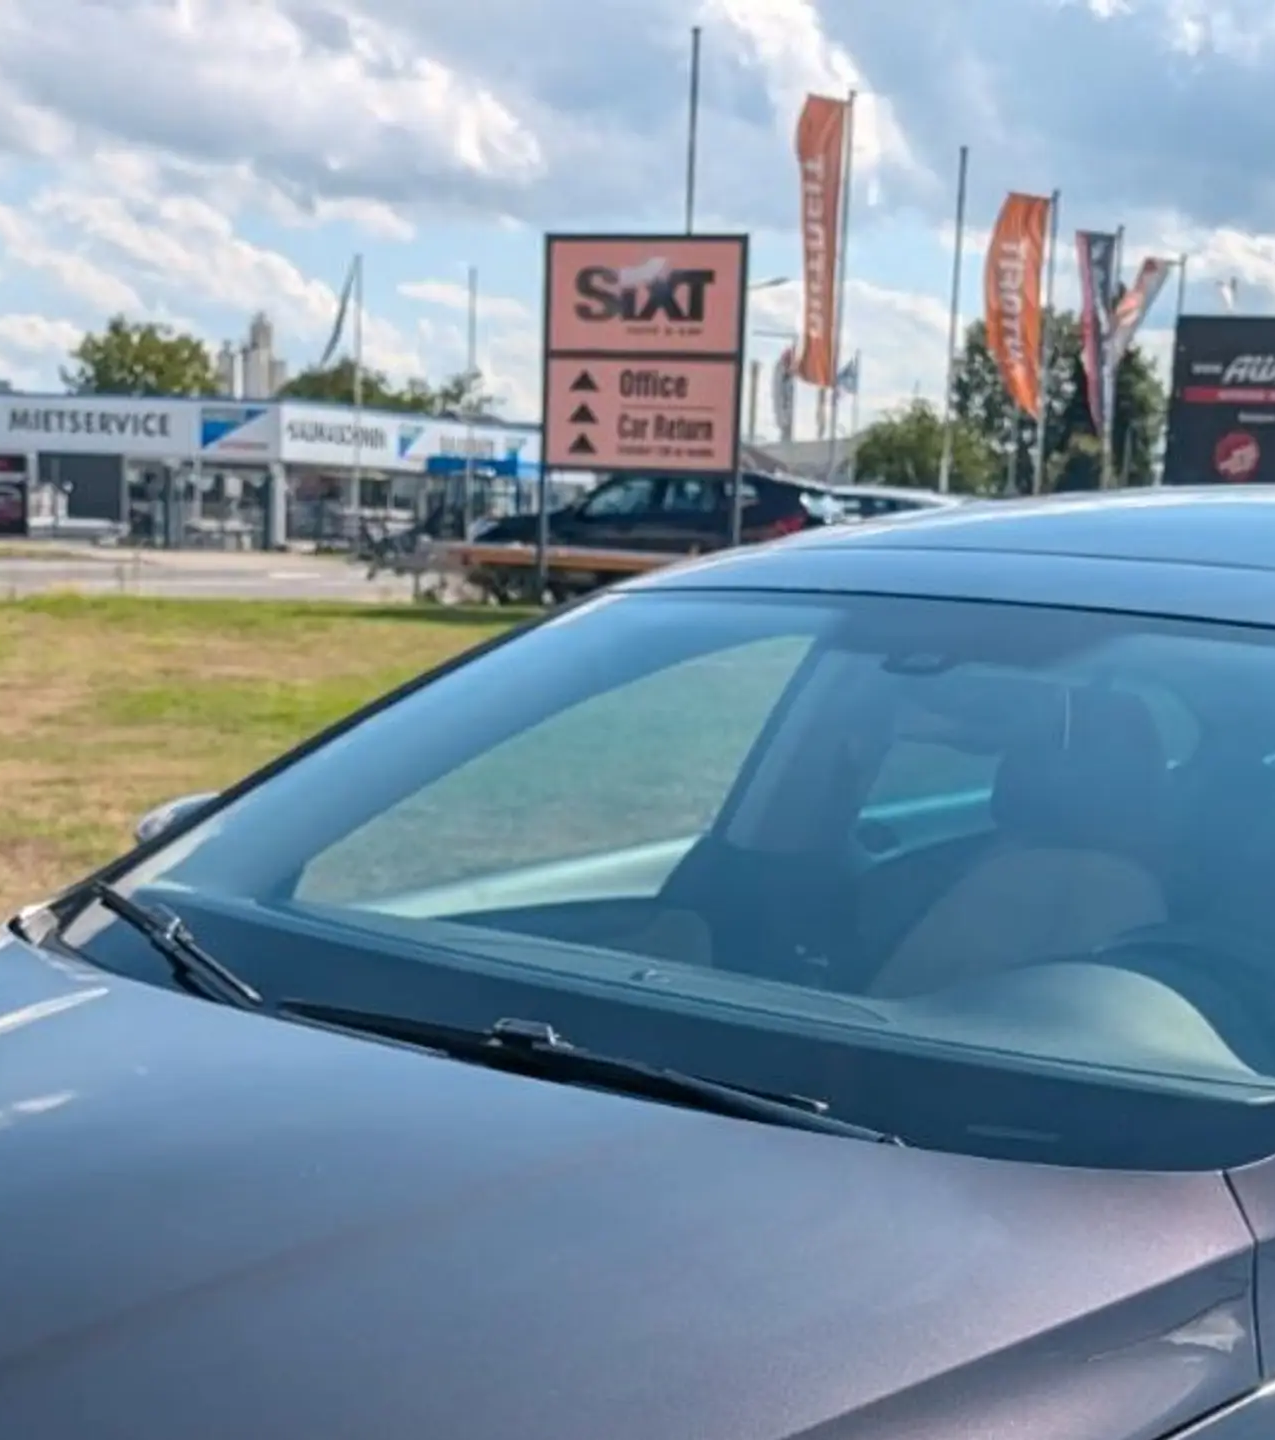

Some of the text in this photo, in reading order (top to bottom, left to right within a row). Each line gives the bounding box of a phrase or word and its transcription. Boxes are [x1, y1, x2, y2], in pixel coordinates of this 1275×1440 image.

[574, 266, 715, 322] SIXT
[619, 369, 688, 398] Office
[8, 408, 172, 438] MIETSERVICE
[616, 413, 714, 442] Car Return
